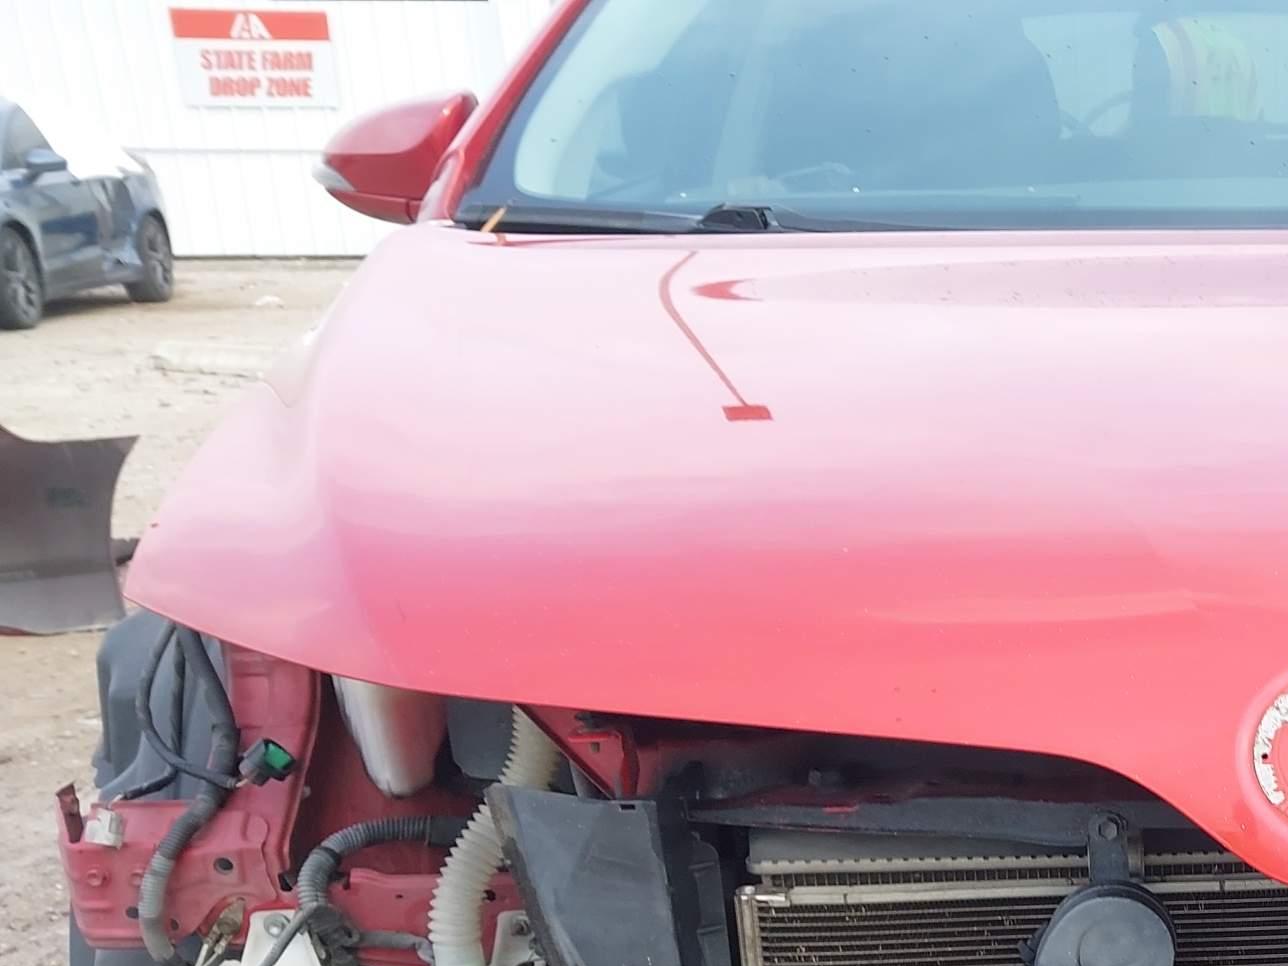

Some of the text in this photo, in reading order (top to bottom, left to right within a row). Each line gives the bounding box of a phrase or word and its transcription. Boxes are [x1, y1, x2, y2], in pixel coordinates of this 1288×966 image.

[200, 50, 313, 71] STATE FARM
[210, 77, 313, 98] DROP ZONE
